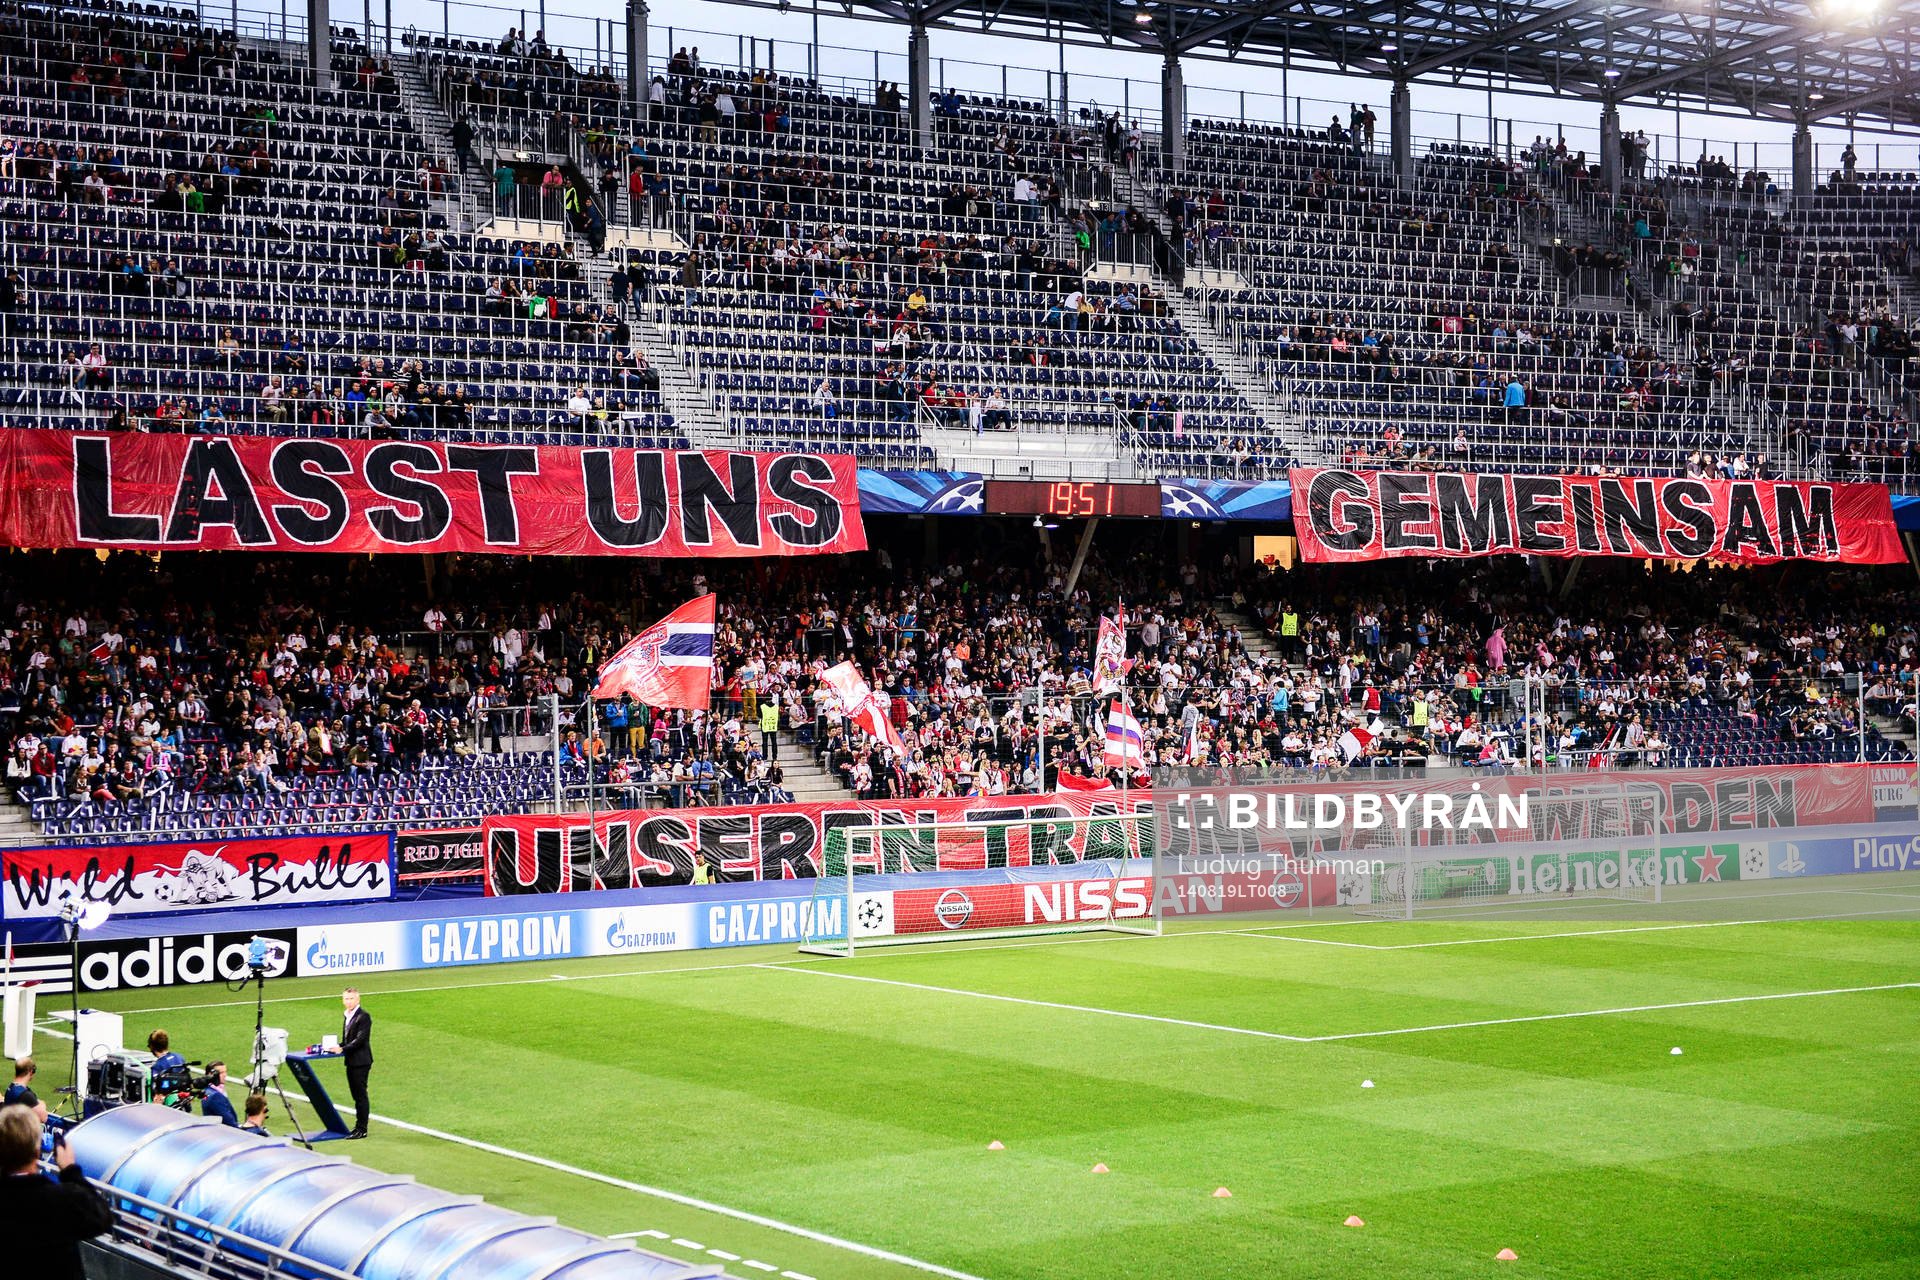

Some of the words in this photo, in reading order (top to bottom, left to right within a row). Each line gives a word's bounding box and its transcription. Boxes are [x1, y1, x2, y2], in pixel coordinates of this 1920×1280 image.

[73, 435, 540, 546] LASST
[581, 448, 843, 549] UNS
[1048, 482, 1113, 515] 19:51
[1308, 469, 1840, 558] GEMEINSAM
[404, 845, 440, 862] RED
[488, 809, 940, 897] UNSEREN
[1524, 776, 1797, 842] WERDEN
[246, 844, 384, 901] Bulls
[1507, 849, 1688, 895] Heineken
[709, 898, 842, 944] GAZPROM
[938, 904, 970, 913] NISSAN
[1024, 874, 1222, 923] NISSAN
[80, 935, 288, 990] adida
[330, 951, 384, 968] GAZPROM
[421, 914, 572, 964] GAZPROM
[627, 931, 676, 948] GAZPROM
